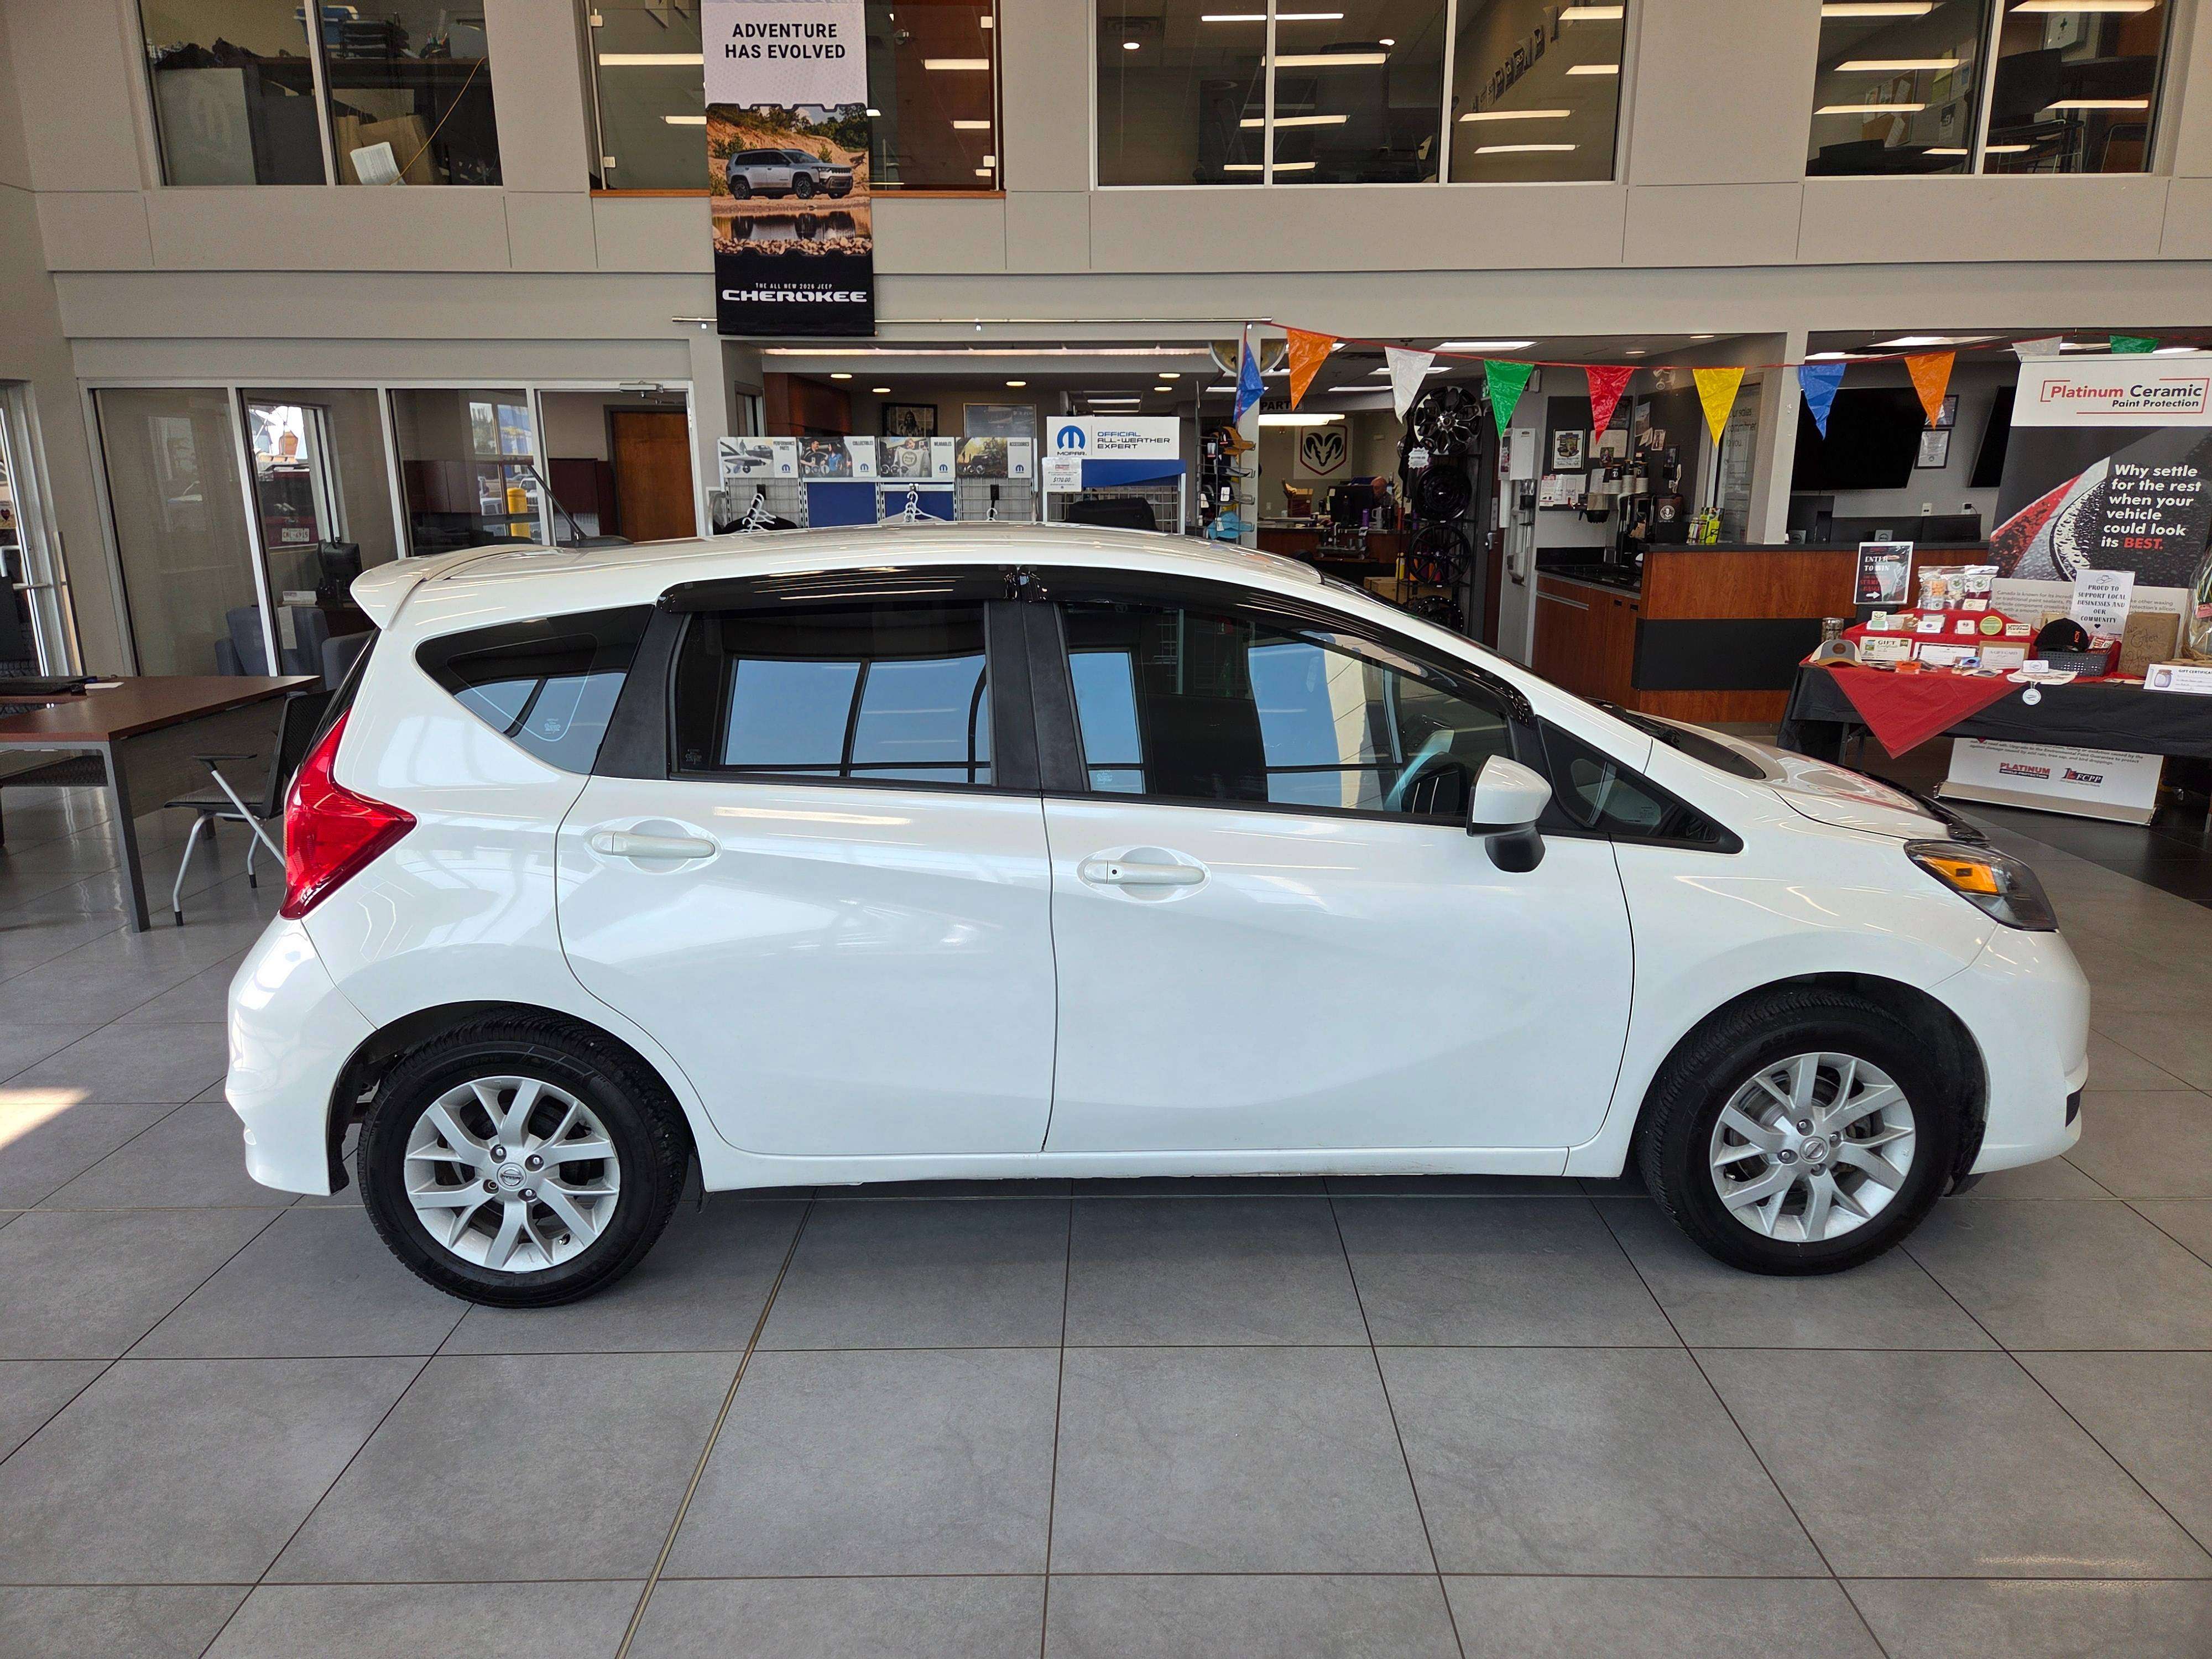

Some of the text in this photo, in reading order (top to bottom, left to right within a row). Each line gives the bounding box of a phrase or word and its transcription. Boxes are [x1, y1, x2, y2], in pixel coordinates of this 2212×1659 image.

[732, 23, 838, 38] ADVENTURE
[725, 44, 846, 59] HAS EVOLVED
[722, 289, 867, 302] CHEROKEE
[2050, 384, 2202, 398] Platinum Ceramic
[1261, 400, 1299, 410] PART
[2112, 399, 2199, 408] Paint Protection
[2115, 464, 2198, 478] Why settle
[2111, 479, 2201, 492] for the rest
[2109, 493, 2194, 508] when your
[2106, 508, 2162, 521] vehicle
[2103, 523, 2187, 536] could look
[2101, 536, 2164, 550] its BEST.
[2000, 762, 2051, 775] PLATINUM
[2076, 774, 2101, 783] FCPP
